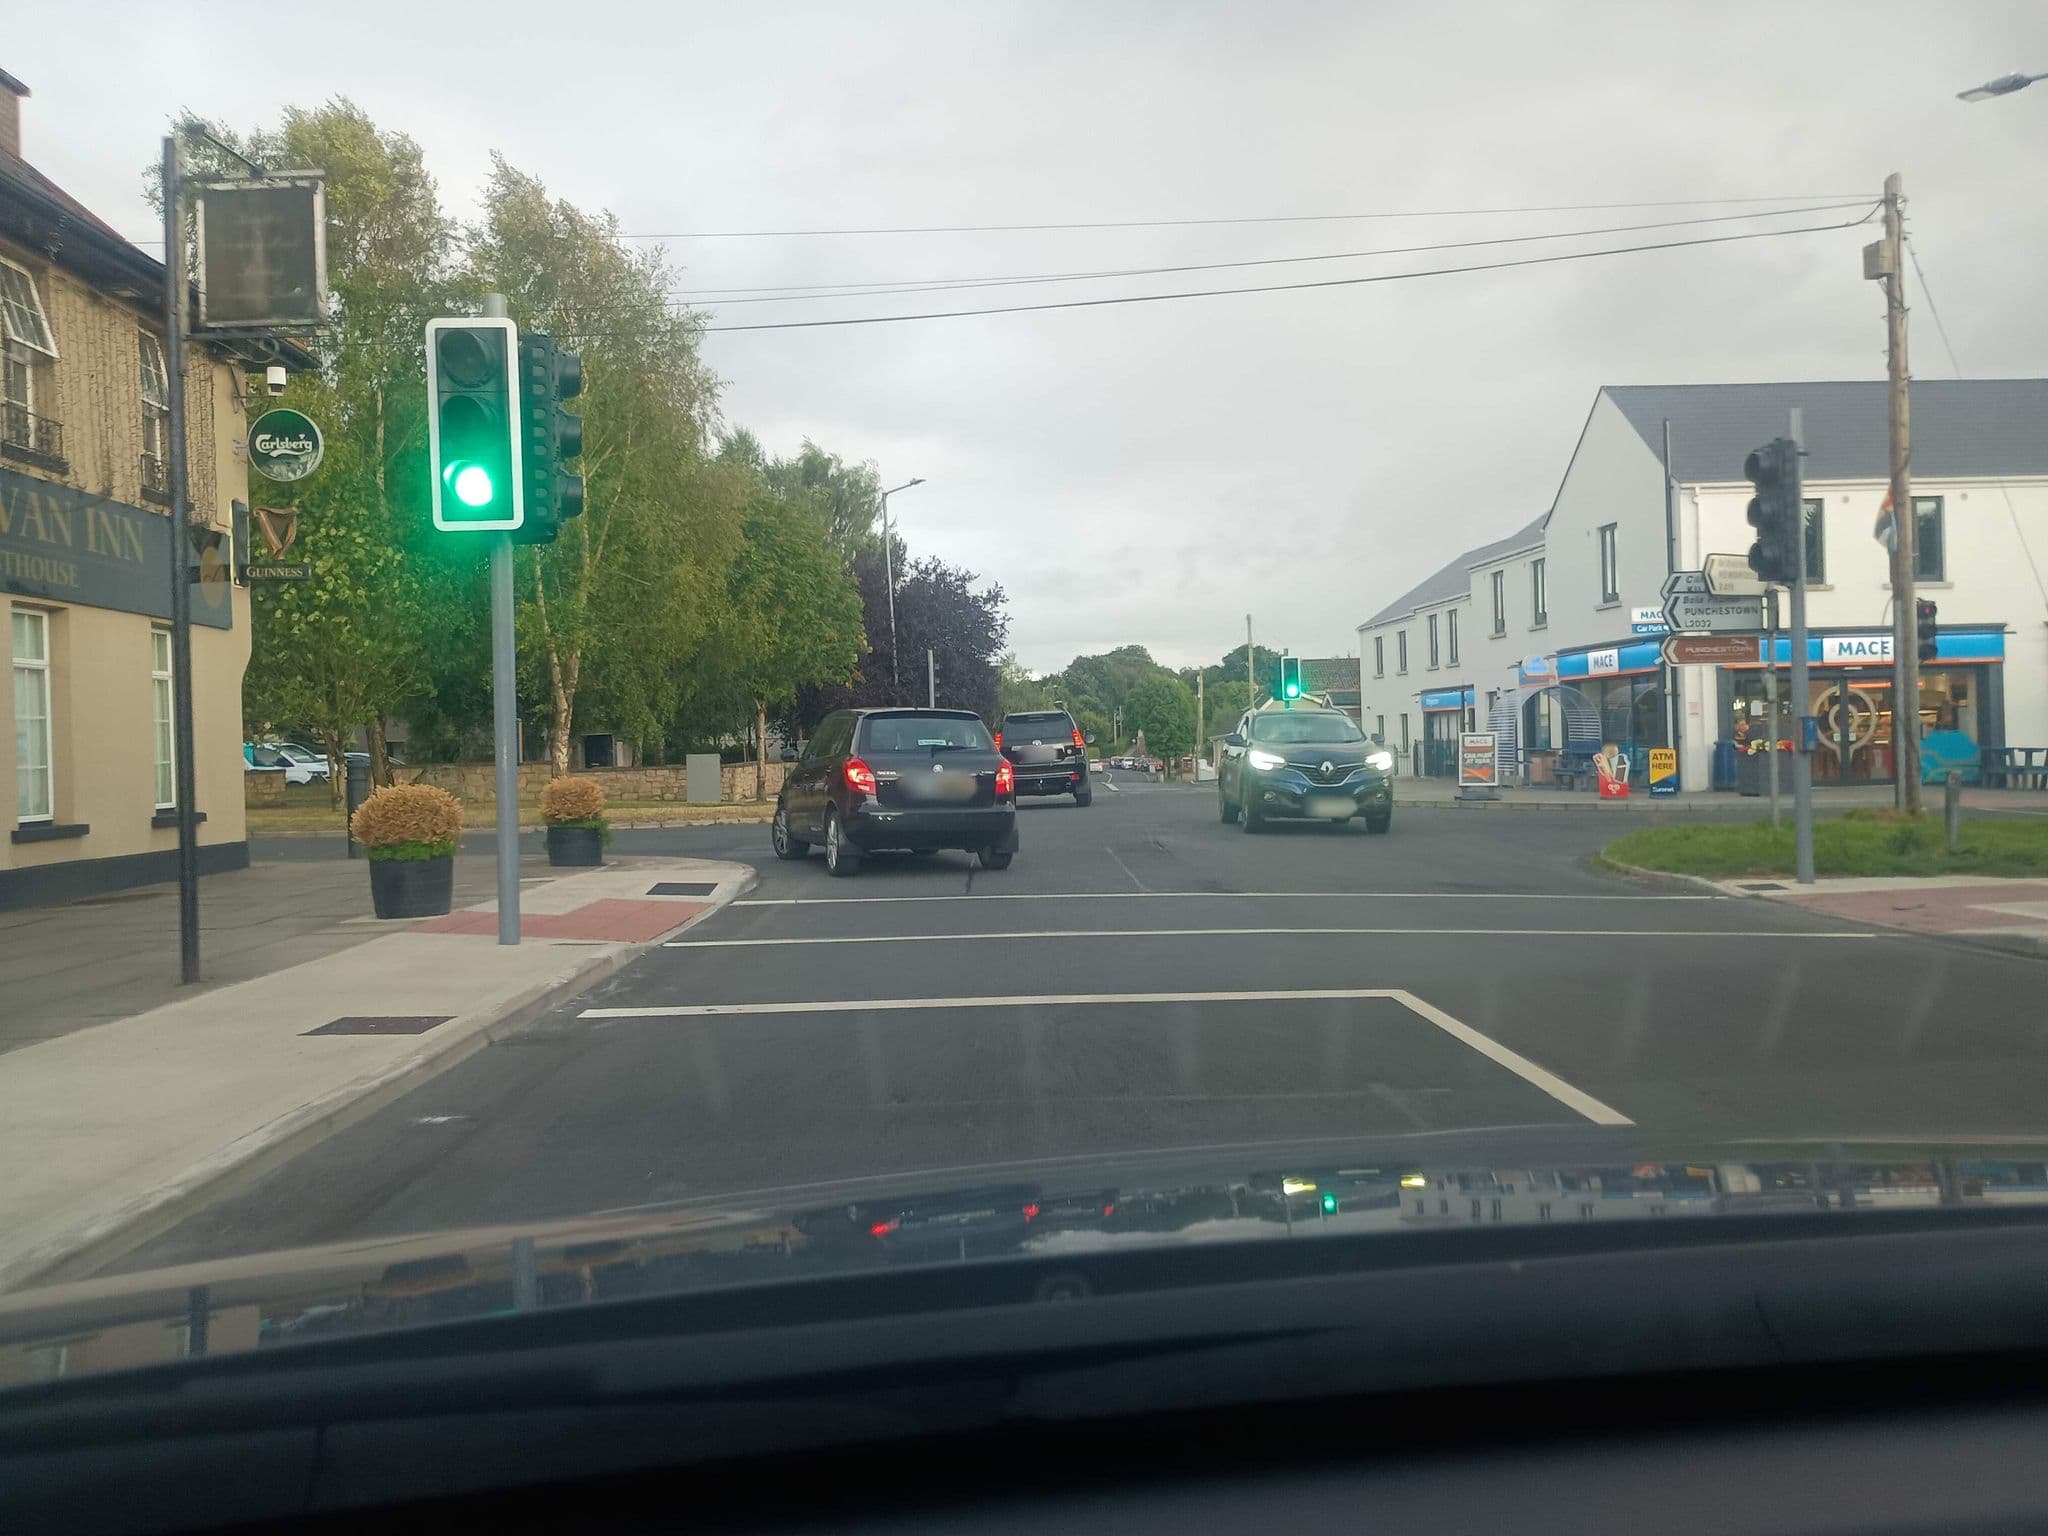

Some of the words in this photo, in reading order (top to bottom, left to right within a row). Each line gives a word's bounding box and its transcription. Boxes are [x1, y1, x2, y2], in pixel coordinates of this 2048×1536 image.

[256, 434, 312, 453] Carlsberg
[86, 507, 144, 566] INN
[246, 566, 303, 577] GUINNESS
[1640, 611, 1663, 619] MAC
[1684, 607, 1758, 616] PUNCHESTOWN
[1838, 641, 1890, 656] MACE
[1593, 655, 1613, 669] MACE
[1652, 753, 1673, 761] ATM
